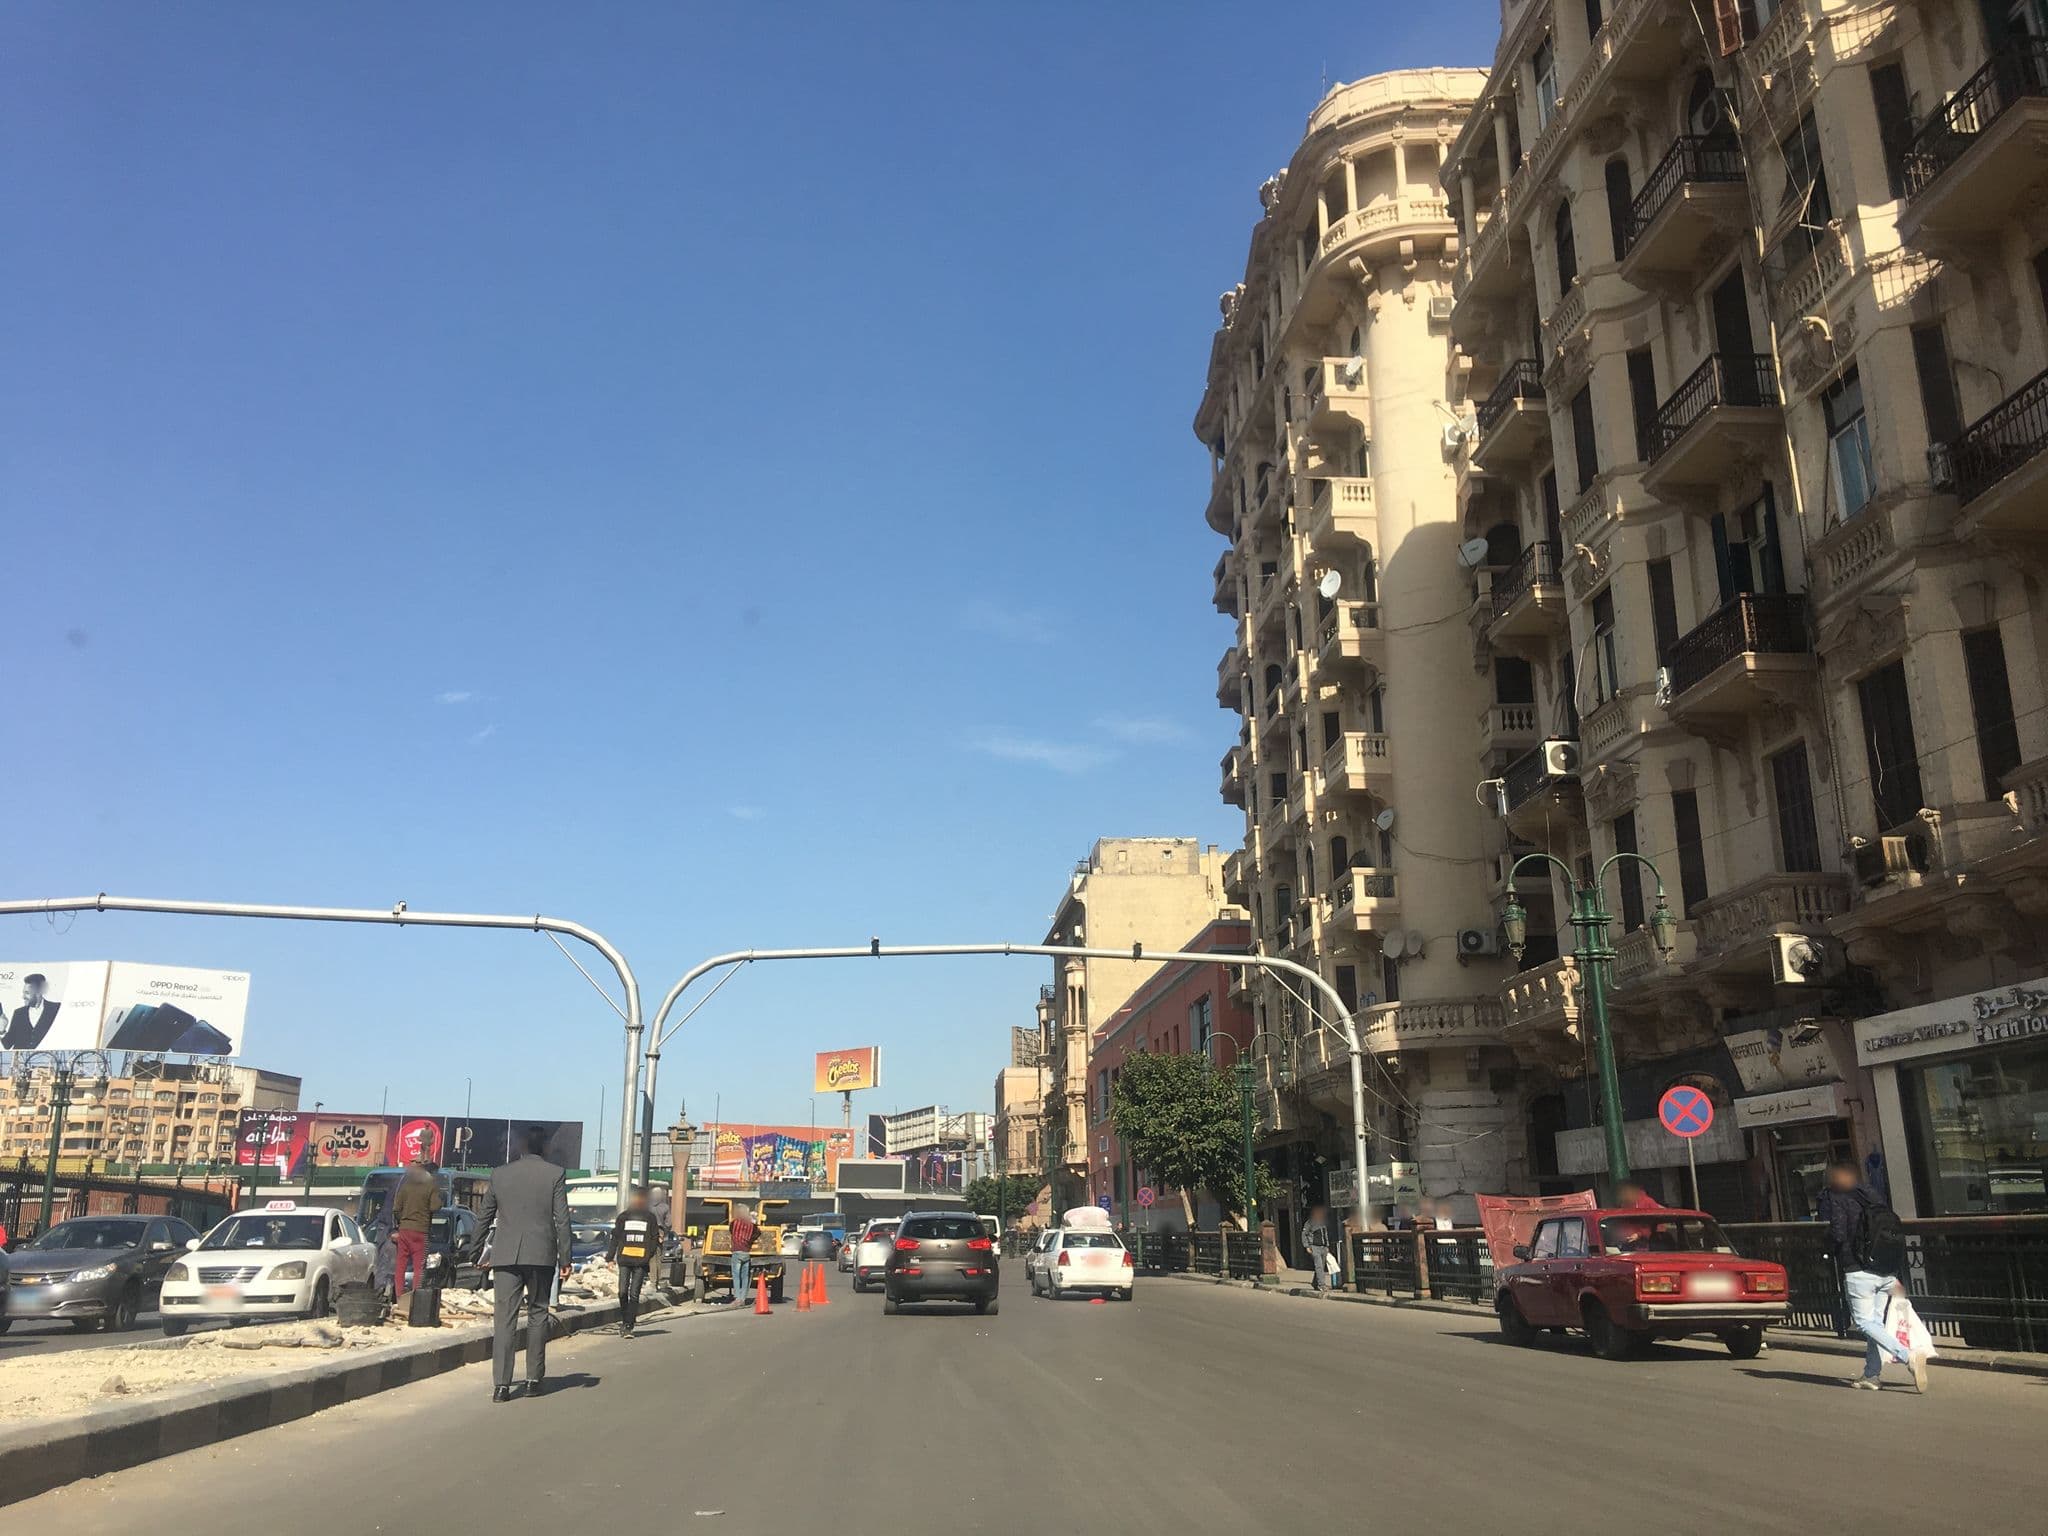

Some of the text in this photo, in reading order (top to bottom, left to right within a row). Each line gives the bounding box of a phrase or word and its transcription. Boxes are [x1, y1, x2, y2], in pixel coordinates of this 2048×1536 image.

[150, 980, 198, 991] OPPO Reno2
[1973, 1017, 2020, 1044] Farah
